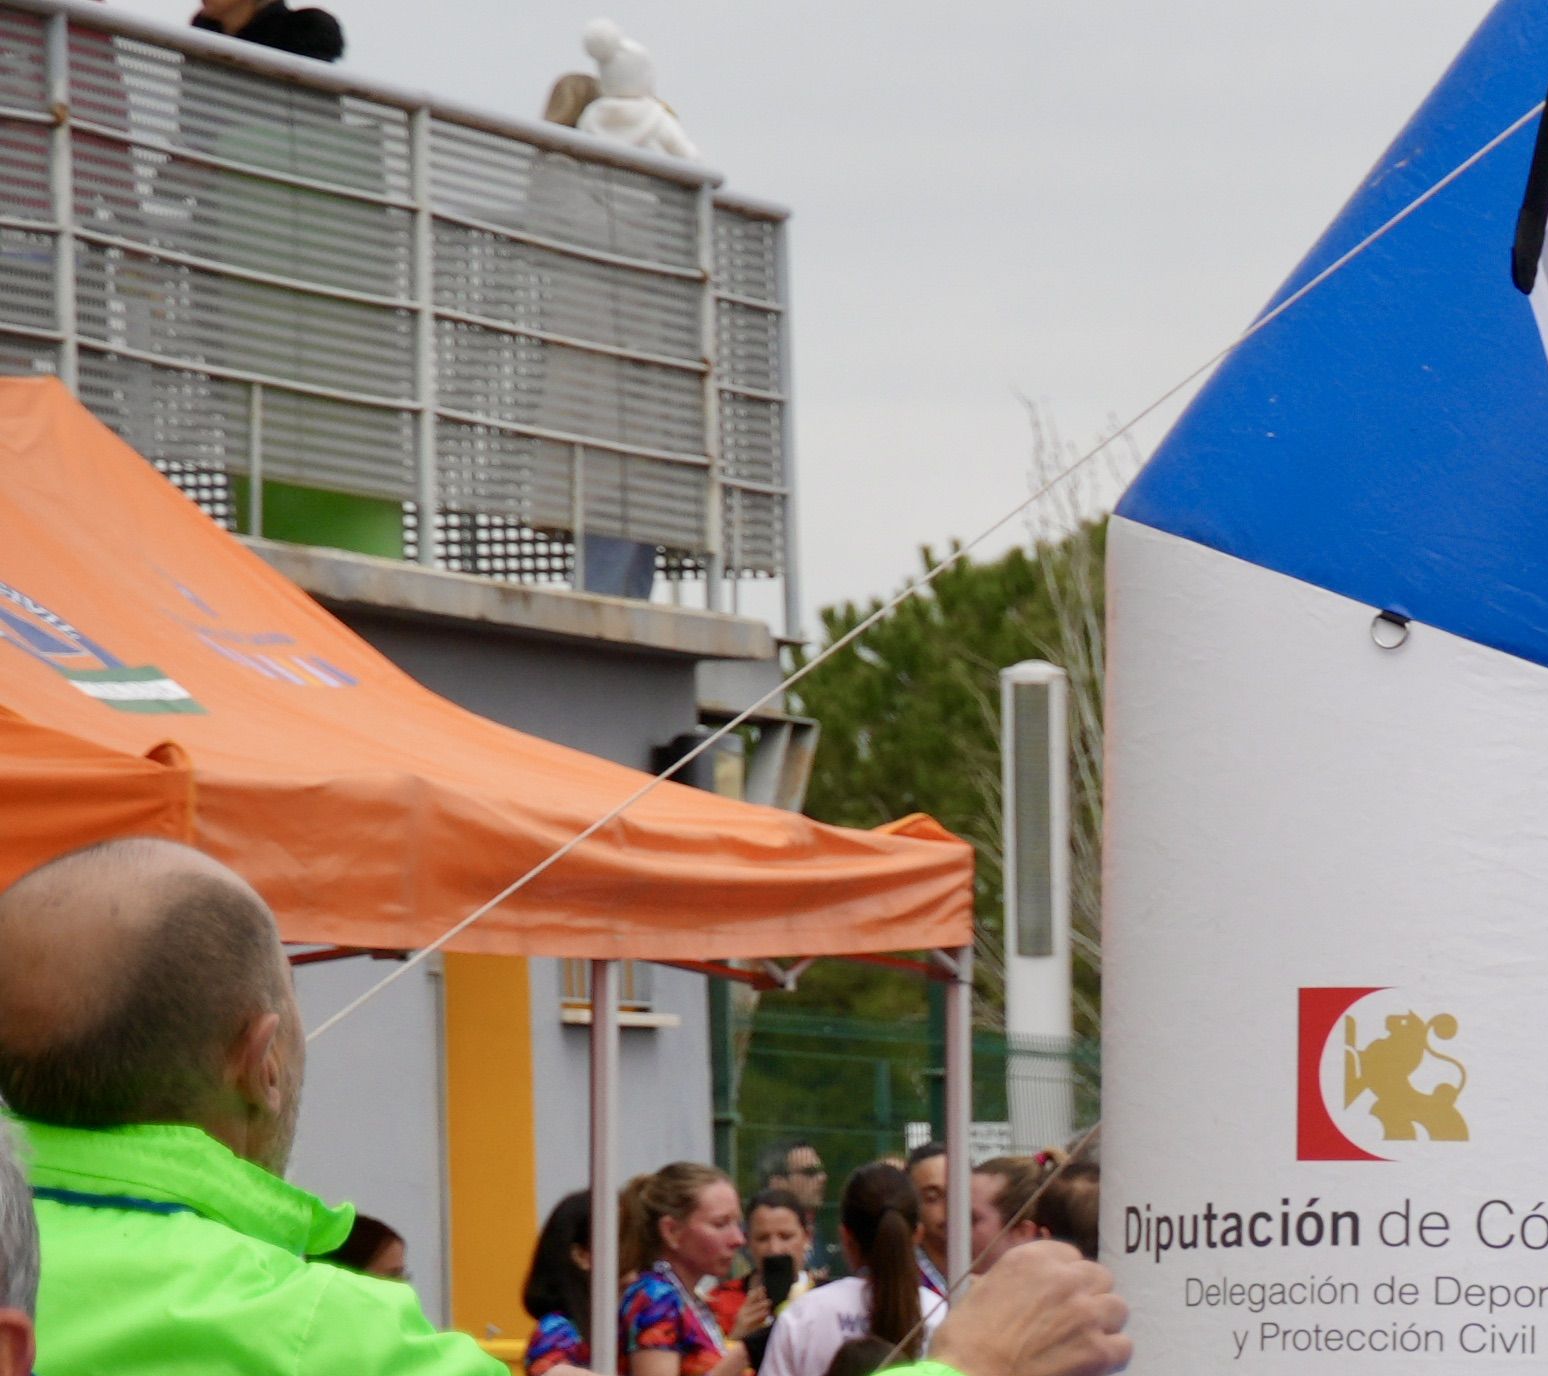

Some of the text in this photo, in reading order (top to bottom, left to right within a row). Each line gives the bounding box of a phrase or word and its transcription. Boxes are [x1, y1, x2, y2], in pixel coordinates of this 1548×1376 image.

[1123, 1198, 1361, 1263] Diputación
[1378, 1199, 1450, 1249] de
[1184, 1275, 1359, 1313] Delegación
[1373, 1276, 1420, 1306] de
[1232, 1321, 1537, 1359] y Protección Civil
